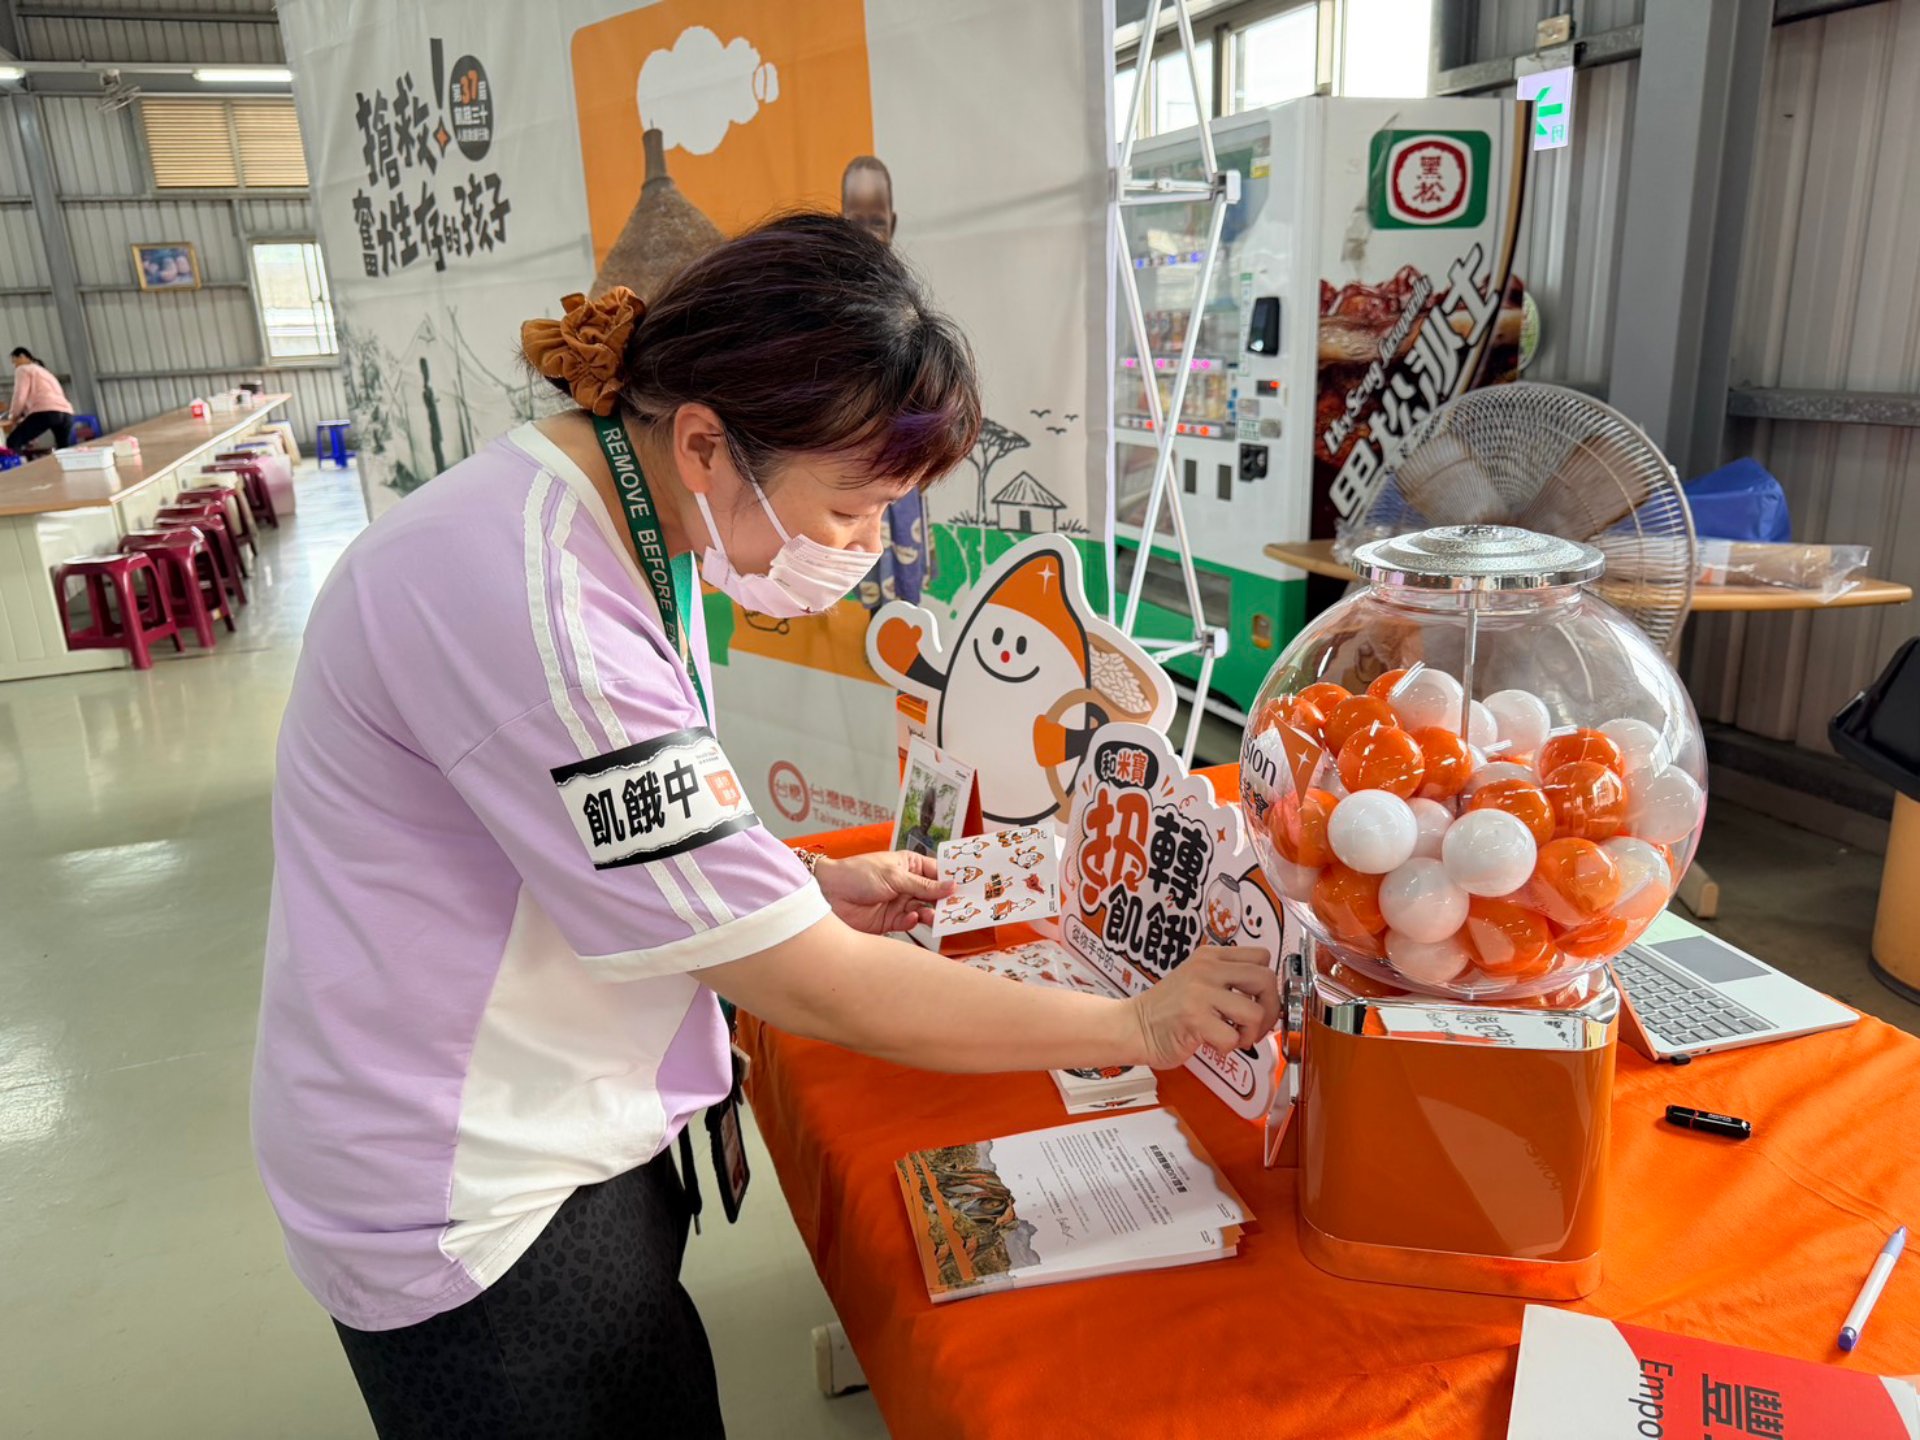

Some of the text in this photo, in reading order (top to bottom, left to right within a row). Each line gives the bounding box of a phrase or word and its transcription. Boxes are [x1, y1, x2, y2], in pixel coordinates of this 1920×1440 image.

[1411, 155, 1446, 204] 黑松
[602, 427, 673, 612] REMOVE BEFORE
[583, 759, 700, 848] 飢餓中
[1101, 750, 1149, 786] 和米寶
[1082, 788, 1208, 910] 扭轉
[1106, 883, 1198, 971] 飢餓
[1702, 1373, 1785, 1440] 豐
